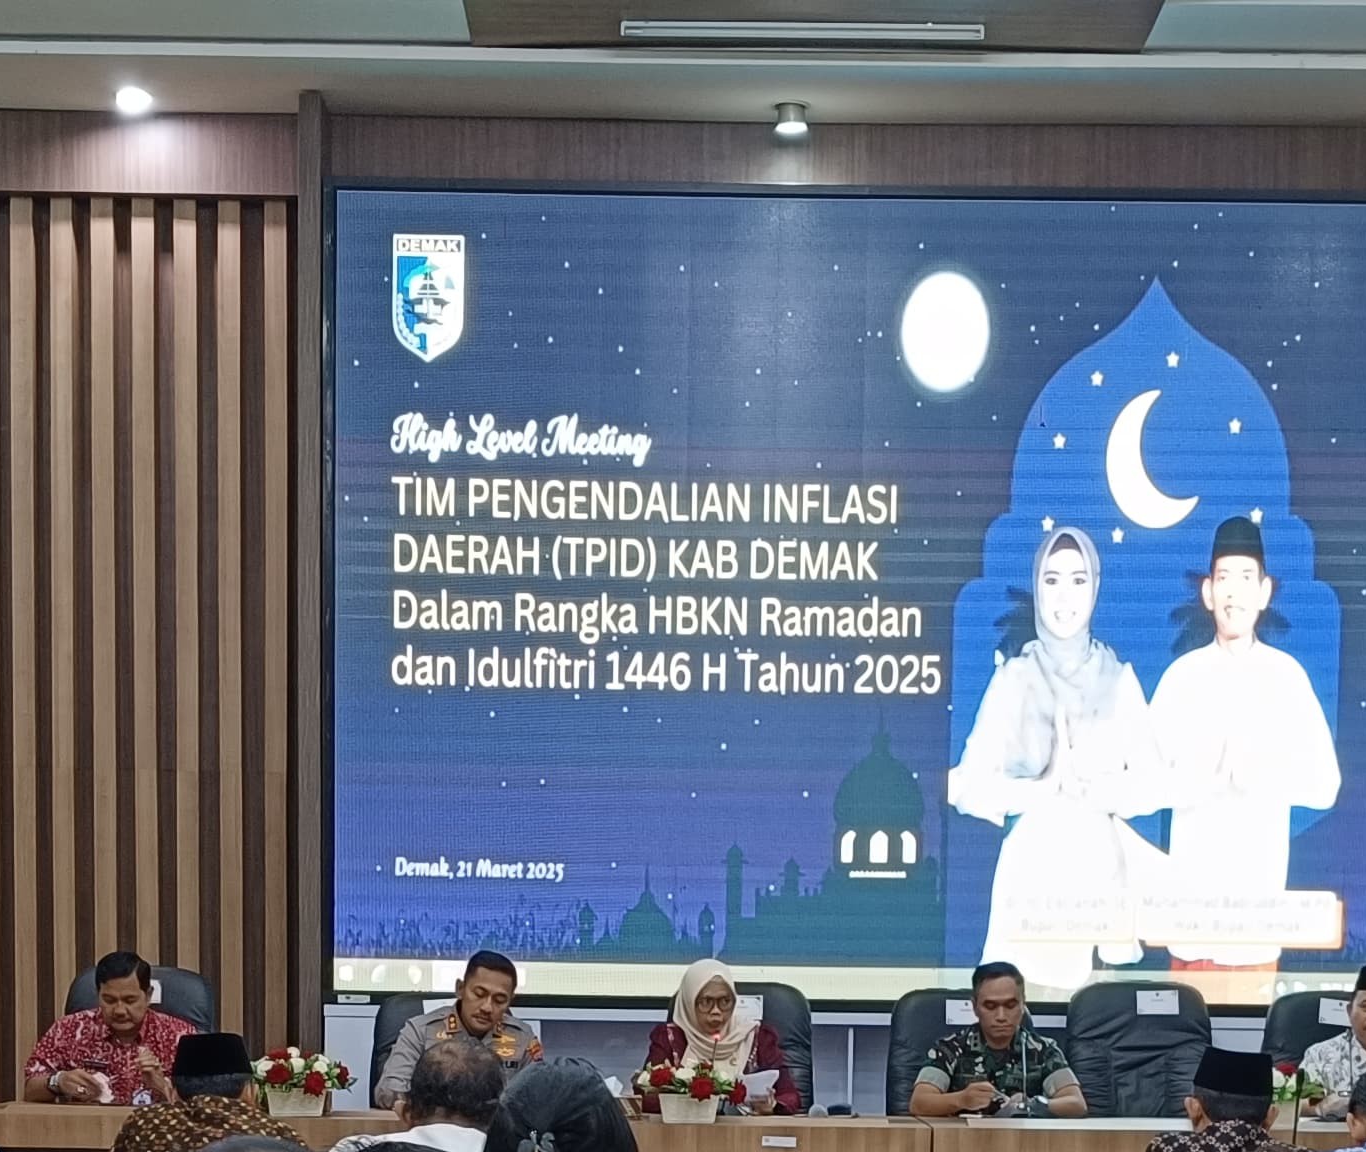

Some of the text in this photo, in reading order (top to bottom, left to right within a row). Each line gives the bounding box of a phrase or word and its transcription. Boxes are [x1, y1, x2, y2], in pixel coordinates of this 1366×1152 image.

[397, 238, 460, 253] DEMAK
[390, 412, 652, 467] High Level Meeting
[391, 476, 899, 525] TIM PENGENDALIAN INFLASI
[393, 533, 878, 583] DAERAH (TPID) KAB DEMAK
[393, 588, 923, 645] Dalam Rangka HBKN Ramadan
[391, 644, 942, 696] dan Idulfitri 1446 H Tahun 2025
[395, 856, 565, 882] Demak, 21 Maret 2025
